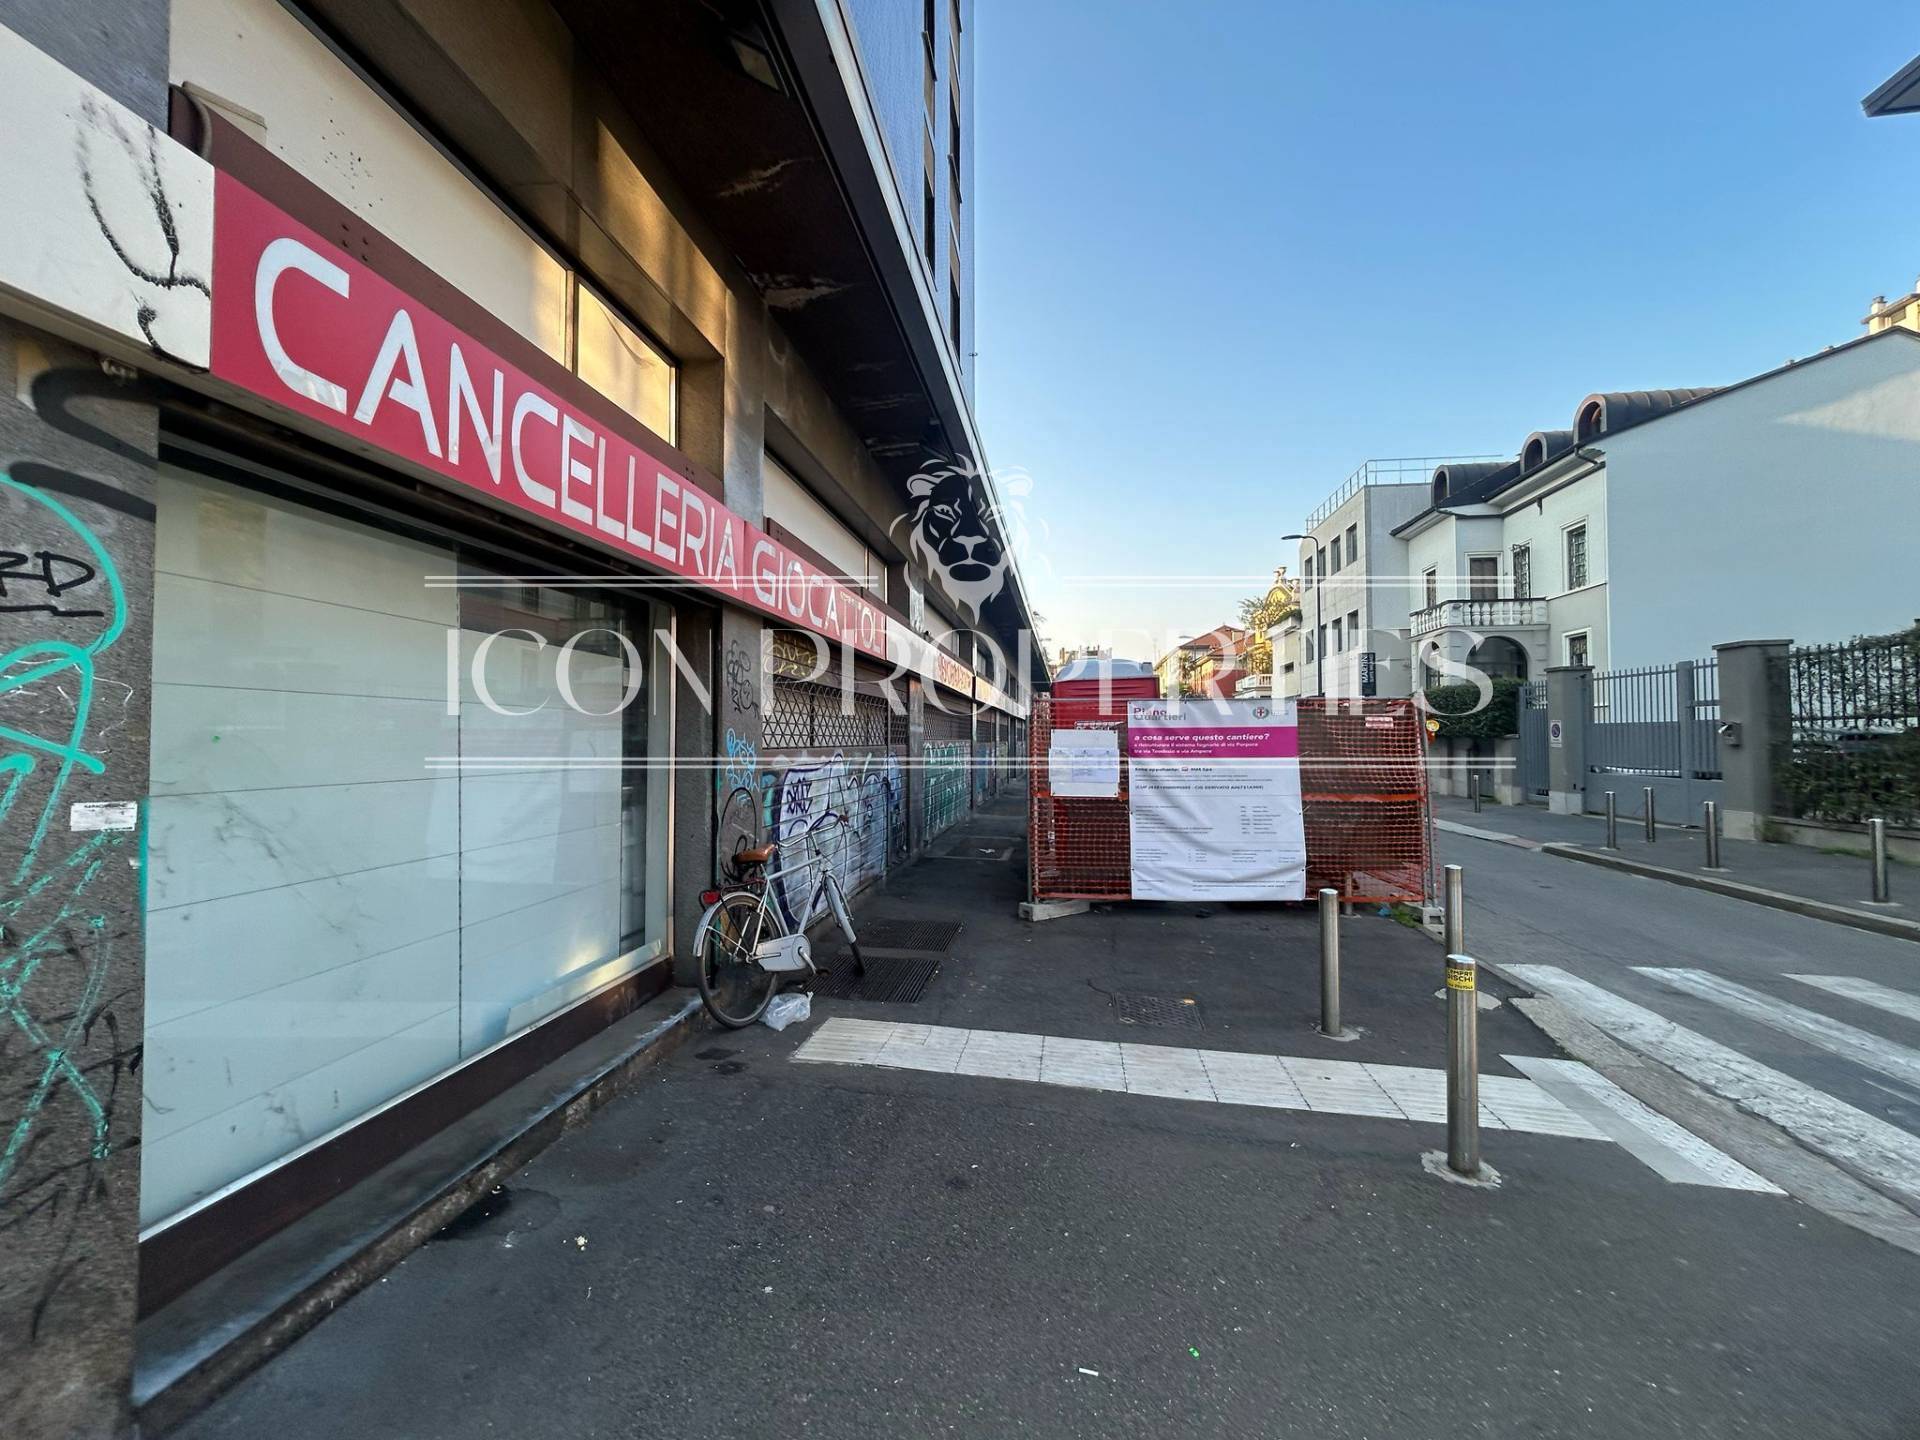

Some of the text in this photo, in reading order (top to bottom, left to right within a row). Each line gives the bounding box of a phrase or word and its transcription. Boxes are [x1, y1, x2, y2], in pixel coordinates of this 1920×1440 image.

[255, 238, 886, 654] CANCELLERIA GIOCATTOLI
[1192, 734, 1225, 742] questo
[1226, 733, 1270, 741] cantiere?
